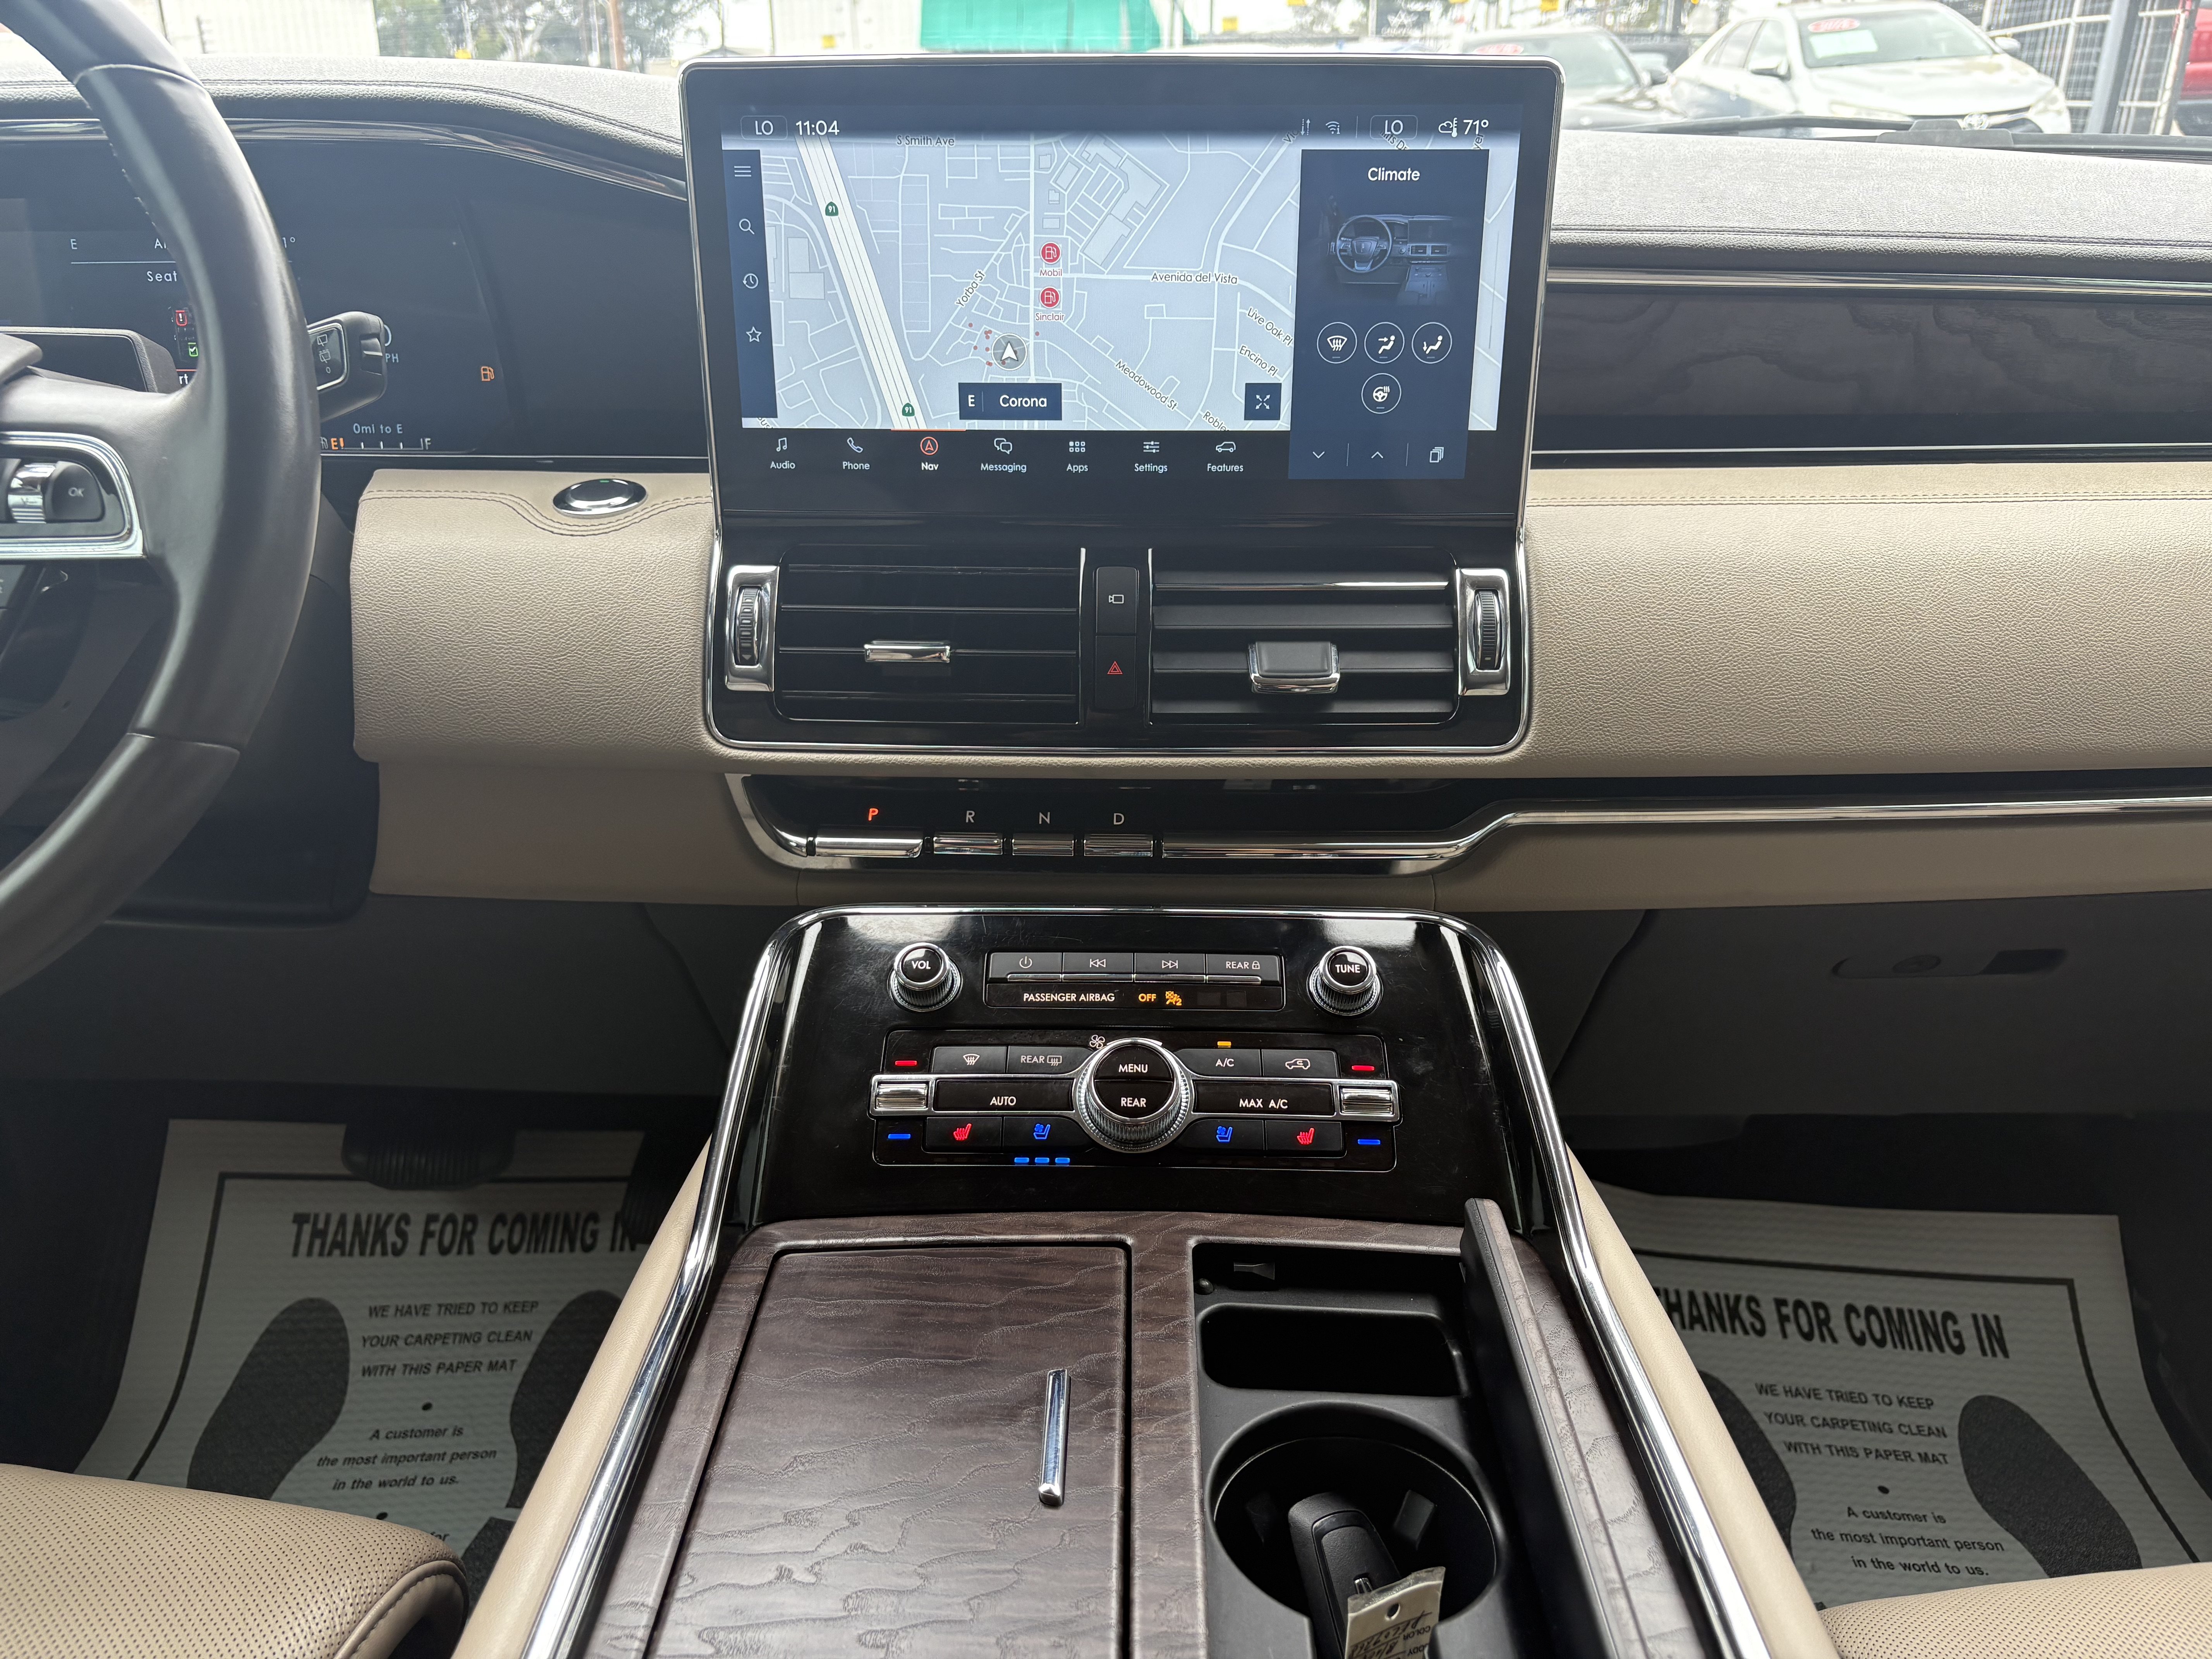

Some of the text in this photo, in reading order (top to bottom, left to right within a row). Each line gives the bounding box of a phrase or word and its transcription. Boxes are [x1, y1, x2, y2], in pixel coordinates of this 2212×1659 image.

[755, 120, 774, 136] LO
[795, 120, 840, 136] 11:04
[1384, 119, 1404, 135] LO
[896, 135, 955, 146] S Smith Ave
[1367, 167, 1420, 181] Climate
[828, 205, 836, 213] 91
[70, 239, 78, 250] E
[147, 271, 177, 282] Seat
[1039, 268, 1062, 276] Mobil
[1151, 272, 1238, 284] Avenida del Vista
[955, 270, 985, 307] Yorba St
[1035, 313, 1065, 321] Sinclair
[1247, 307, 1293, 346] Live Oak Pl
[1239, 345, 1278, 376] Encino Pl
[1115, 360, 1177, 410] Meadowood St
[968, 395, 1047, 408] E Corona
[904, 406, 912, 414] 91
[1202, 411, 1229, 431] Roble
[380, 424, 392, 434] to
[397, 424, 403, 434] E
[769, 460, 796, 469] Audio
[842, 461, 870, 471] Phone
[921, 462, 939, 471] Nav
[980, 463, 1027, 473] Messaging
[1066, 463, 1089, 473] Apps
[1134, 463, 1168, 473] Settings
[1206, 463, 1244, 473] Features
[68, 487, 85, 497] OK
[867, 807, 879, 821] P
[965, 809, 975, 823] R
[1039, 811, 1051, 825] N
[1113, 812, 1125, 826] D
[912, 961, 931, 970] VOL
[1226, 961, 1249, 969] REAR
[1335, 964, 1360, 974] TUNE
[1023, 993, 1115, 1002] PASSENGER AIRBAG
[1138, 993, 1156, 1002] OFF
[1020, 1055, 1045, 1063] REAR
[1216, 1058, 1235, 1067] A/C
[1118, 1064, 1148, 1073] MENU
[990, 1096, 1017, 1106] AUTO
[1121, 1098, 1146, 1107] REAR
[1239, 1099, 1288, 1110] MAX A/C
[292, 1212, 411, 1258] THANKS
[419, 1212, 479, 1256] FOR
[488, 1211, 600, 1255] COMING
[369, 1301, 539, 1319] WE HAVE TRIED TO KEEP
[1653, 1286, 2010, 1359] HANKS FOR COMING IN
[362, 1330, 533, 1348] YOUR CARPETING CLEAN
[362, 1359, 517, 1377] WITH THIS PAPER MAT
[1755, 1382, 1934, 1410] WE HAVE TRIED TO KEEP
[1764, 1412, 1948, 1438] YOUR CARPETING CLEAN
[369, 1426, 464, 1441] A customer is
[317, 1449, 497, 1467] the most important person
[1783, 1441, 1949, 1465] WITH THIS PAPER MAT
[332, 1475, 459, 1491] in the world to us.
[1847, 1507, 1946, 1524] A customer is
[1811, 1528, 2004, 1553] the most important person
[1851, 1556, 1989, 1577] in the world to us.
[1403, 1625, 1431, 1640] COLOR
[1407, 1644, 1429, 1657] ODY
